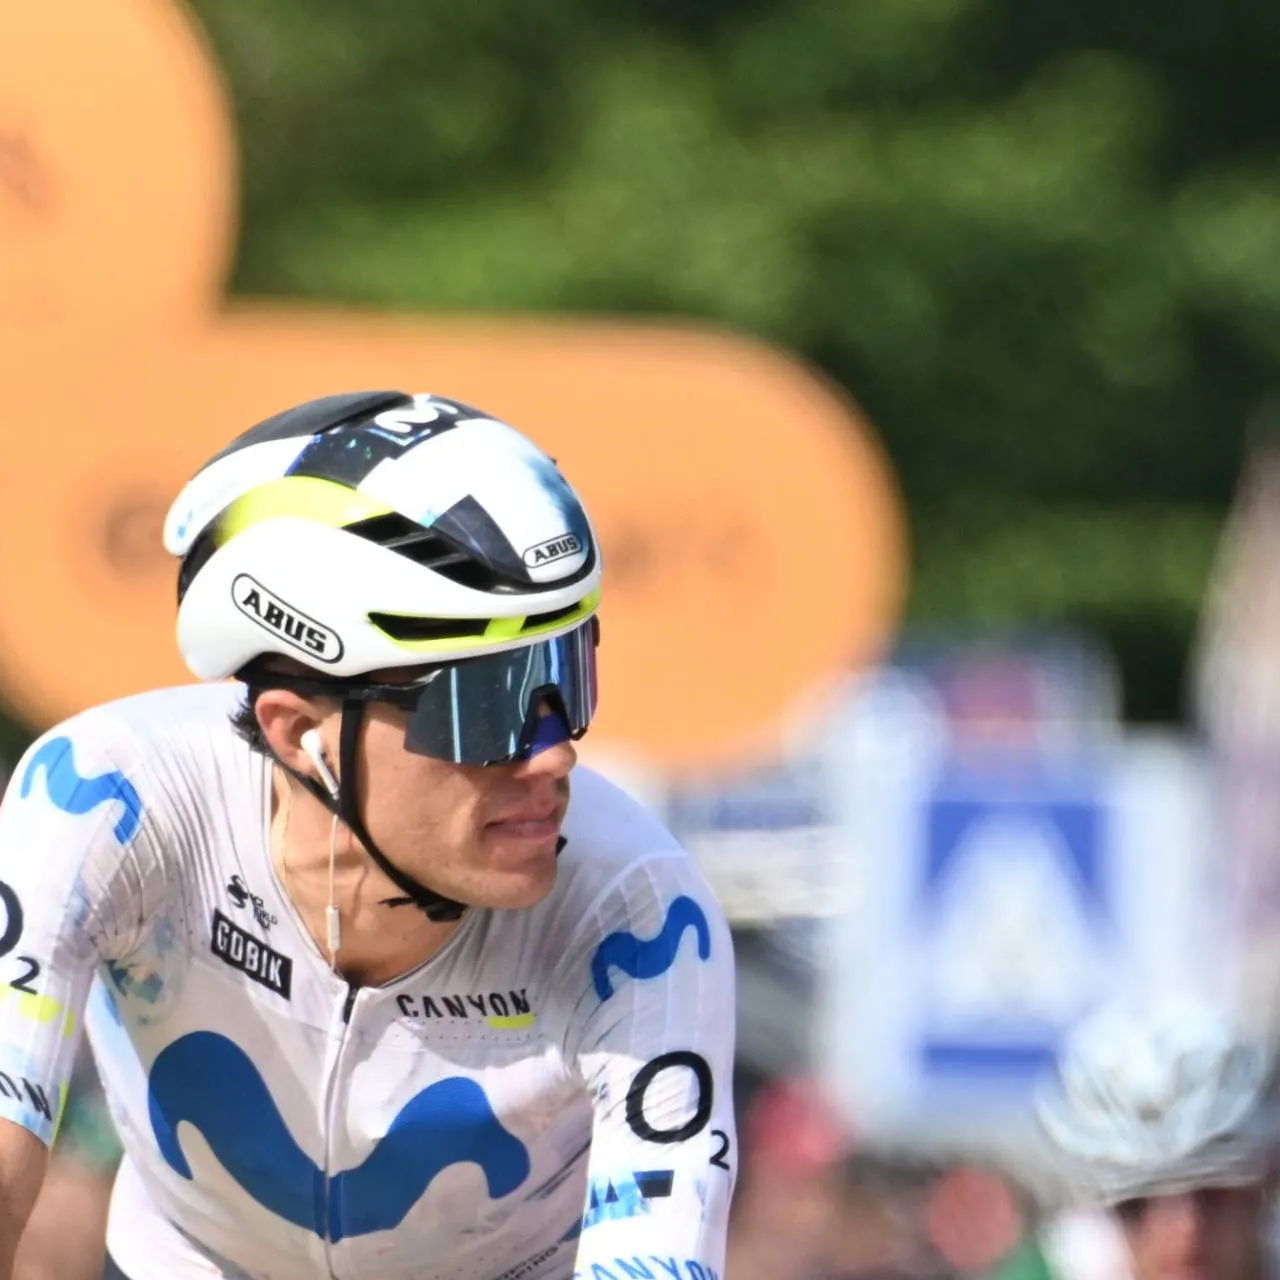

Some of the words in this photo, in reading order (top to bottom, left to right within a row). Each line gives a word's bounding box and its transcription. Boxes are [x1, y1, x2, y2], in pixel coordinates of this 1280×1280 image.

[532, 536, 579, 564] ABUS
[241, 586, 328, 655] ABUS
[216, 919, 283, 989] GOBIK
[396, 988, 532, 1019] CANYON
